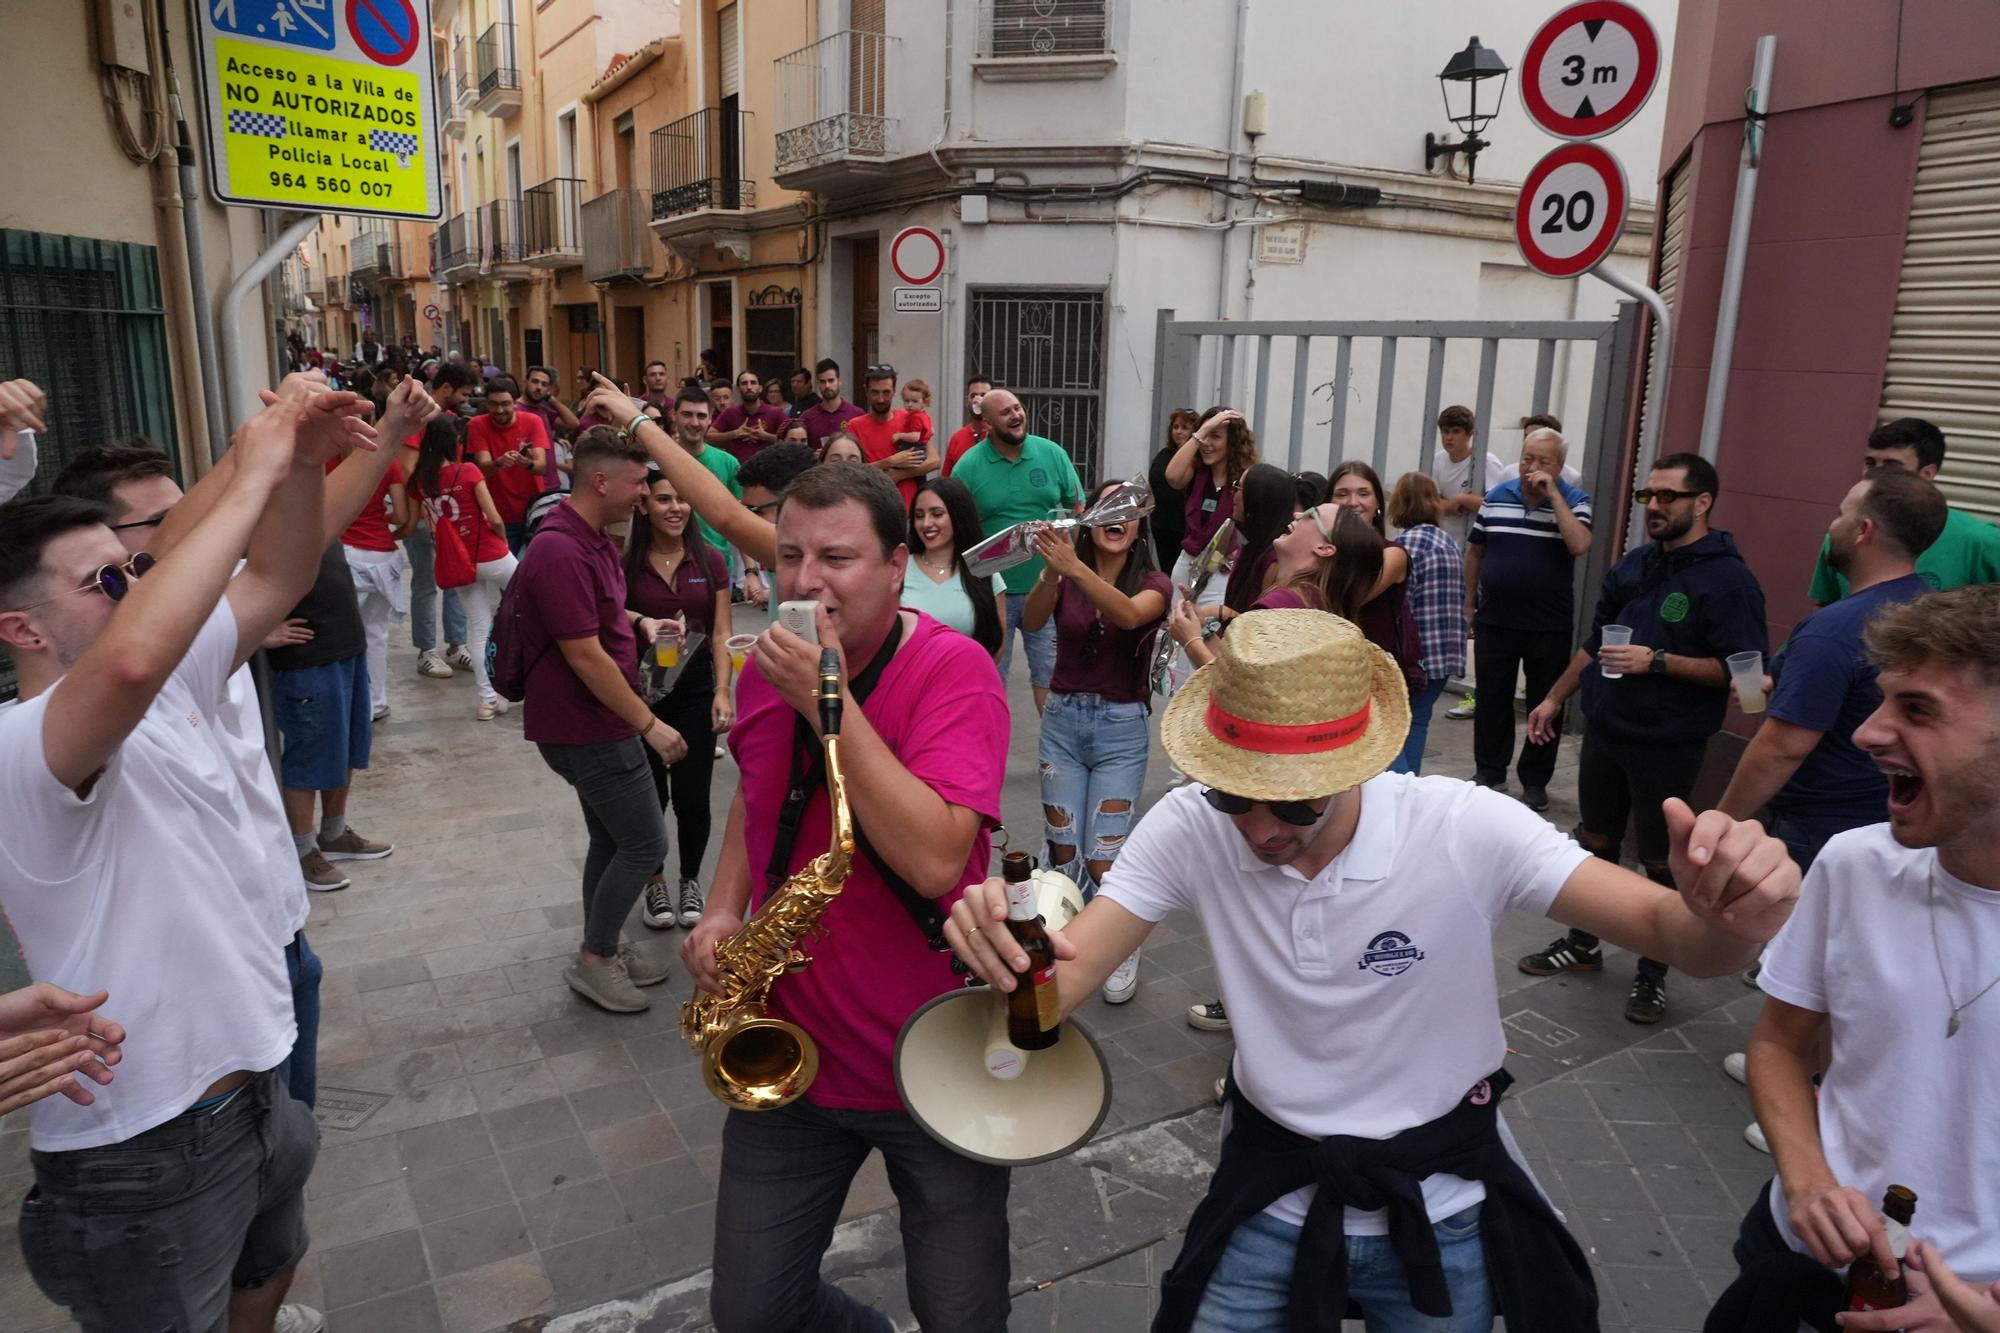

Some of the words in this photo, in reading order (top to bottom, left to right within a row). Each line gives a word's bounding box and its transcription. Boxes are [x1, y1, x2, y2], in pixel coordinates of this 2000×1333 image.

[227, 57, 297, 83] Acceso
[307, 73, 317, 86] a
[326, 74, 343, 91] la
[353, 79, 385, 98] Vila
[394, 87, 413, 102] de
[1561, 55, 1585, 86] 3
[1592, 65, 1617, 85] m
[226, 83, 259, 104] NO
[272, 91, 416, 127] AUTORIZADOS
[290, 121, 347, 143] llamar
[358, 132, 367, 145] a
[269, 144, 332, 166] Policia
[342, 153, 389, 173] Local
[270, 171, 307, 189] 964
[317, 177, 351, 194] 560
[360, 182, 392, 197] 007
[1541, 190, 1595, 234] 20
